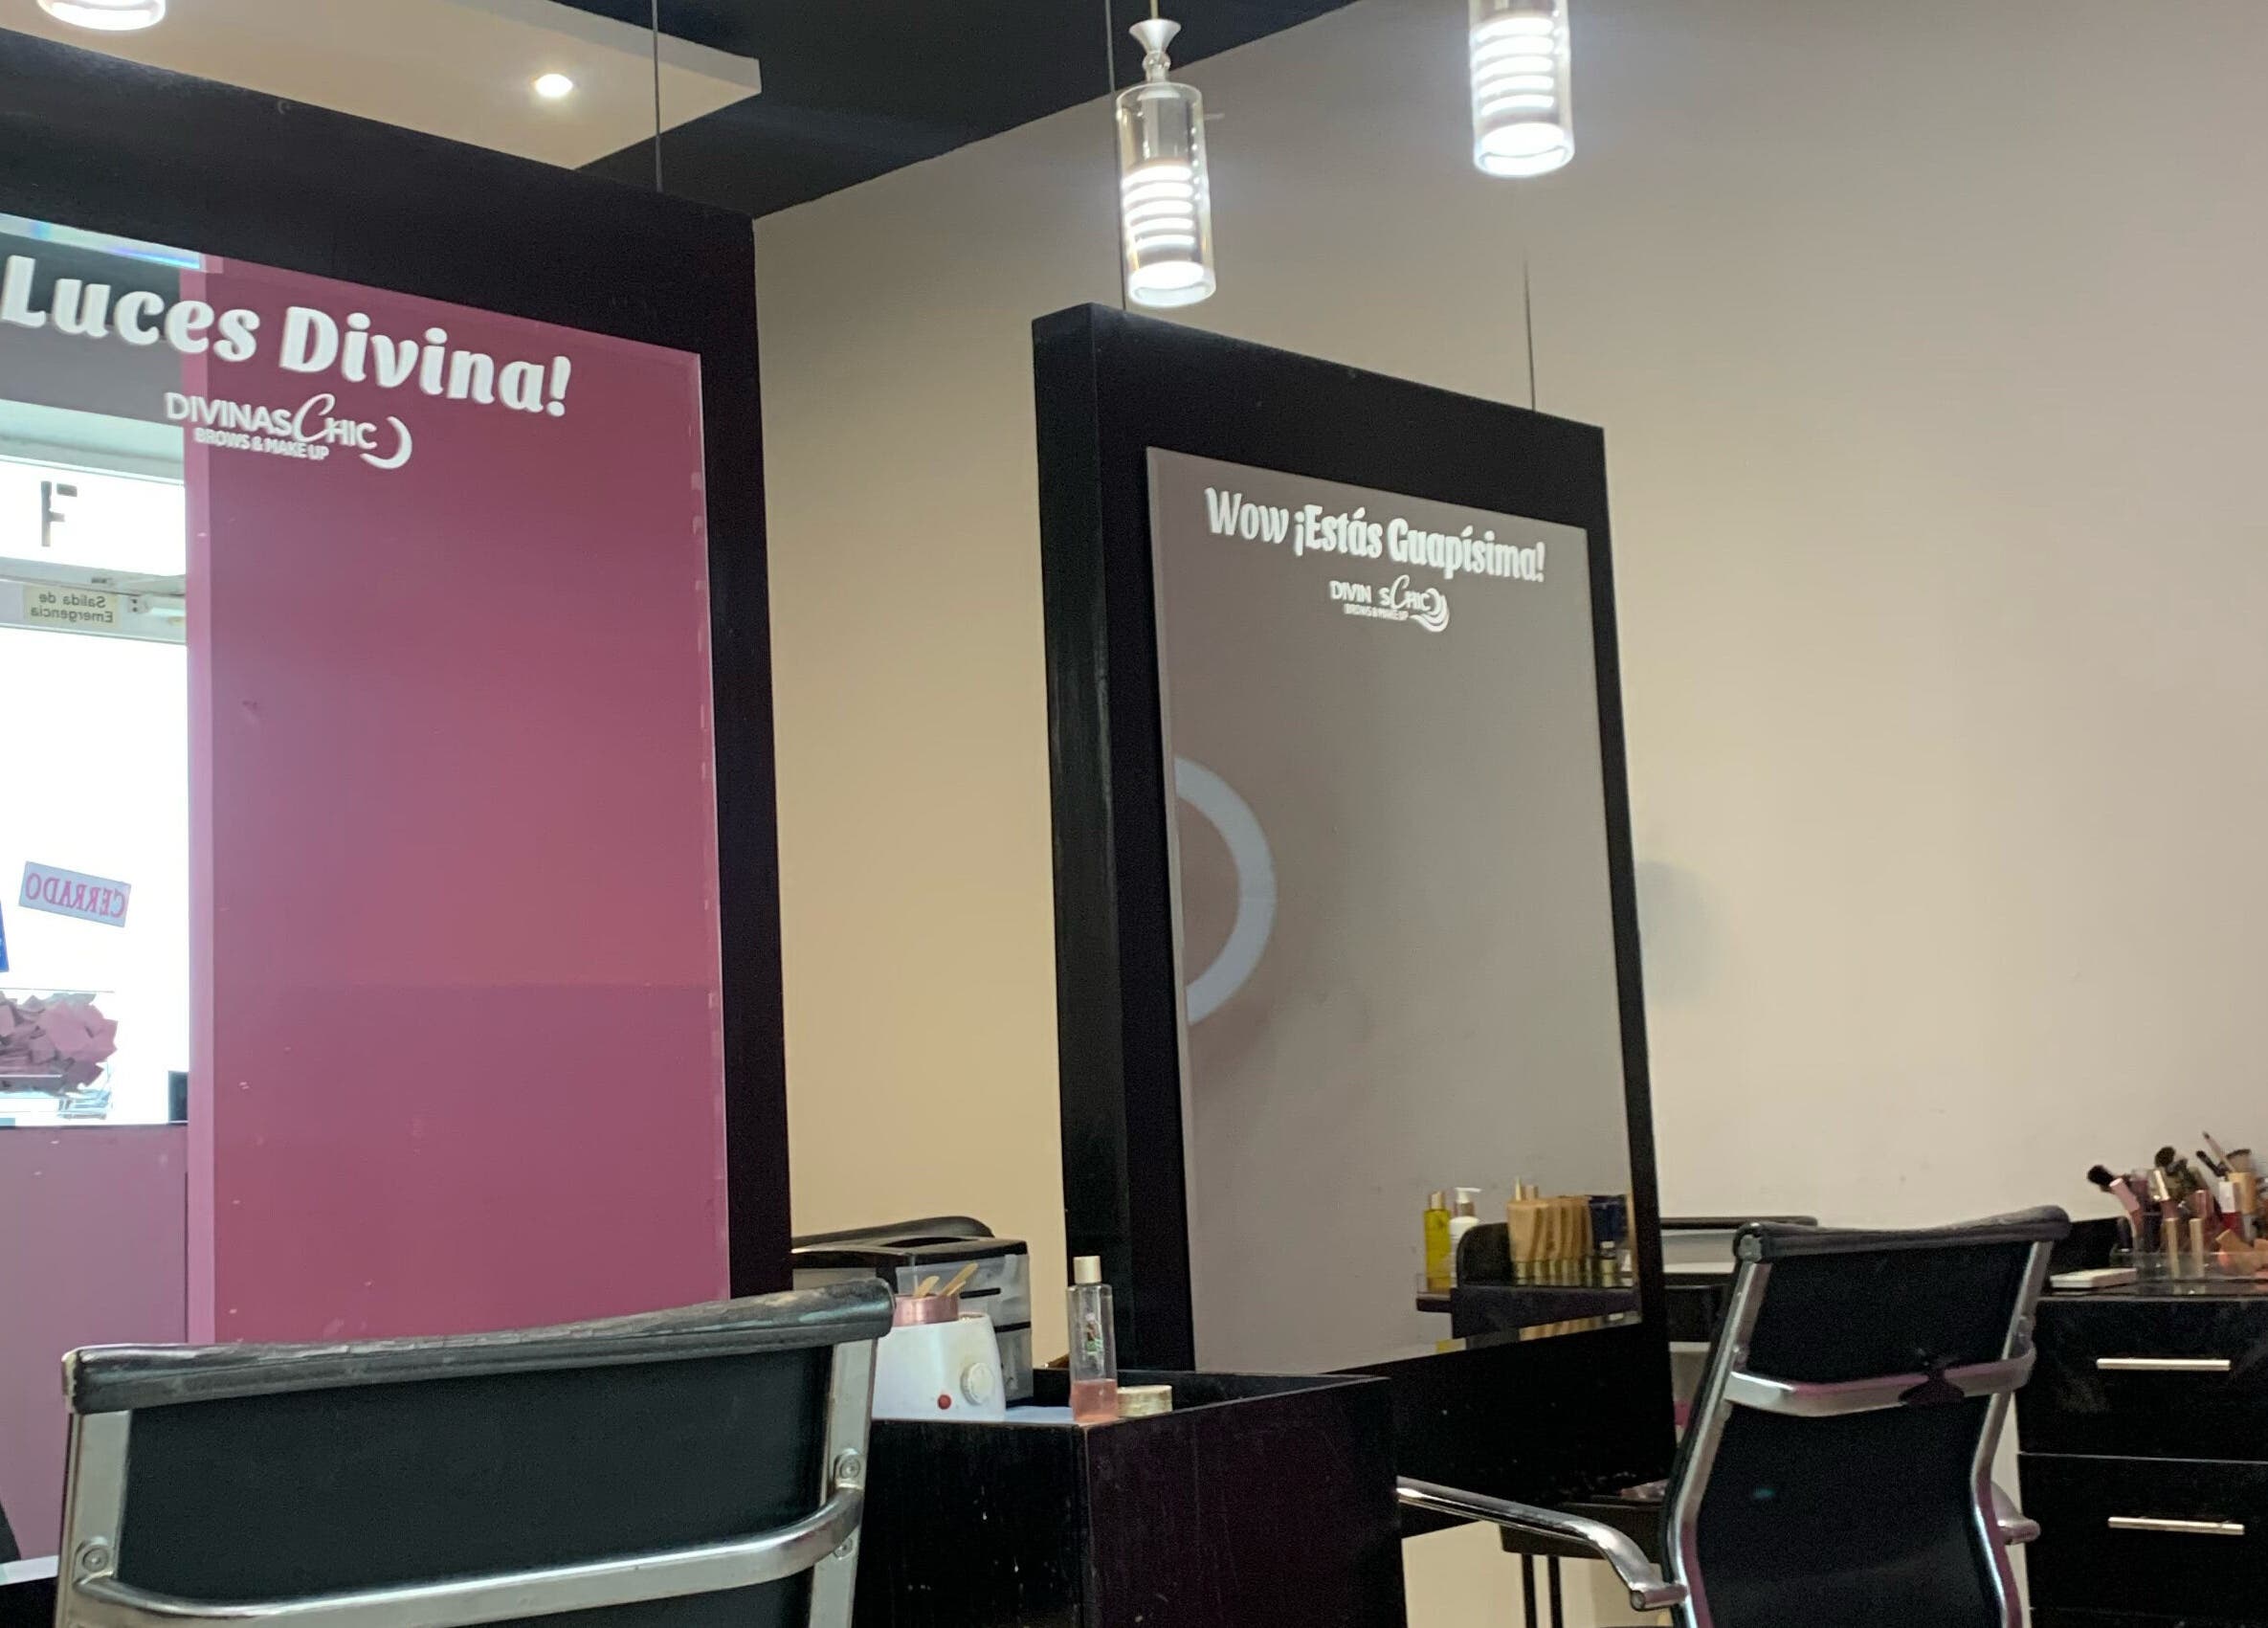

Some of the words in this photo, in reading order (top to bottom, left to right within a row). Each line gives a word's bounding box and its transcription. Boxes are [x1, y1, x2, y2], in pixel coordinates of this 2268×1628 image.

[1, 255, 261, 363] Luces
[279, 305, 572, 418] Divina!
[165, 391, 293, 437] DIVINAS
[194, 427, 251, 452] BROWS
[264, 436, 307, 459] MAKE
[307, 443, 330, 460] UP
[1204, 486, 1290, 545] Wow
[1294, 503, 1384, 557] ¡Estás
[1387, 517, 1545, 583] Guapísima!
